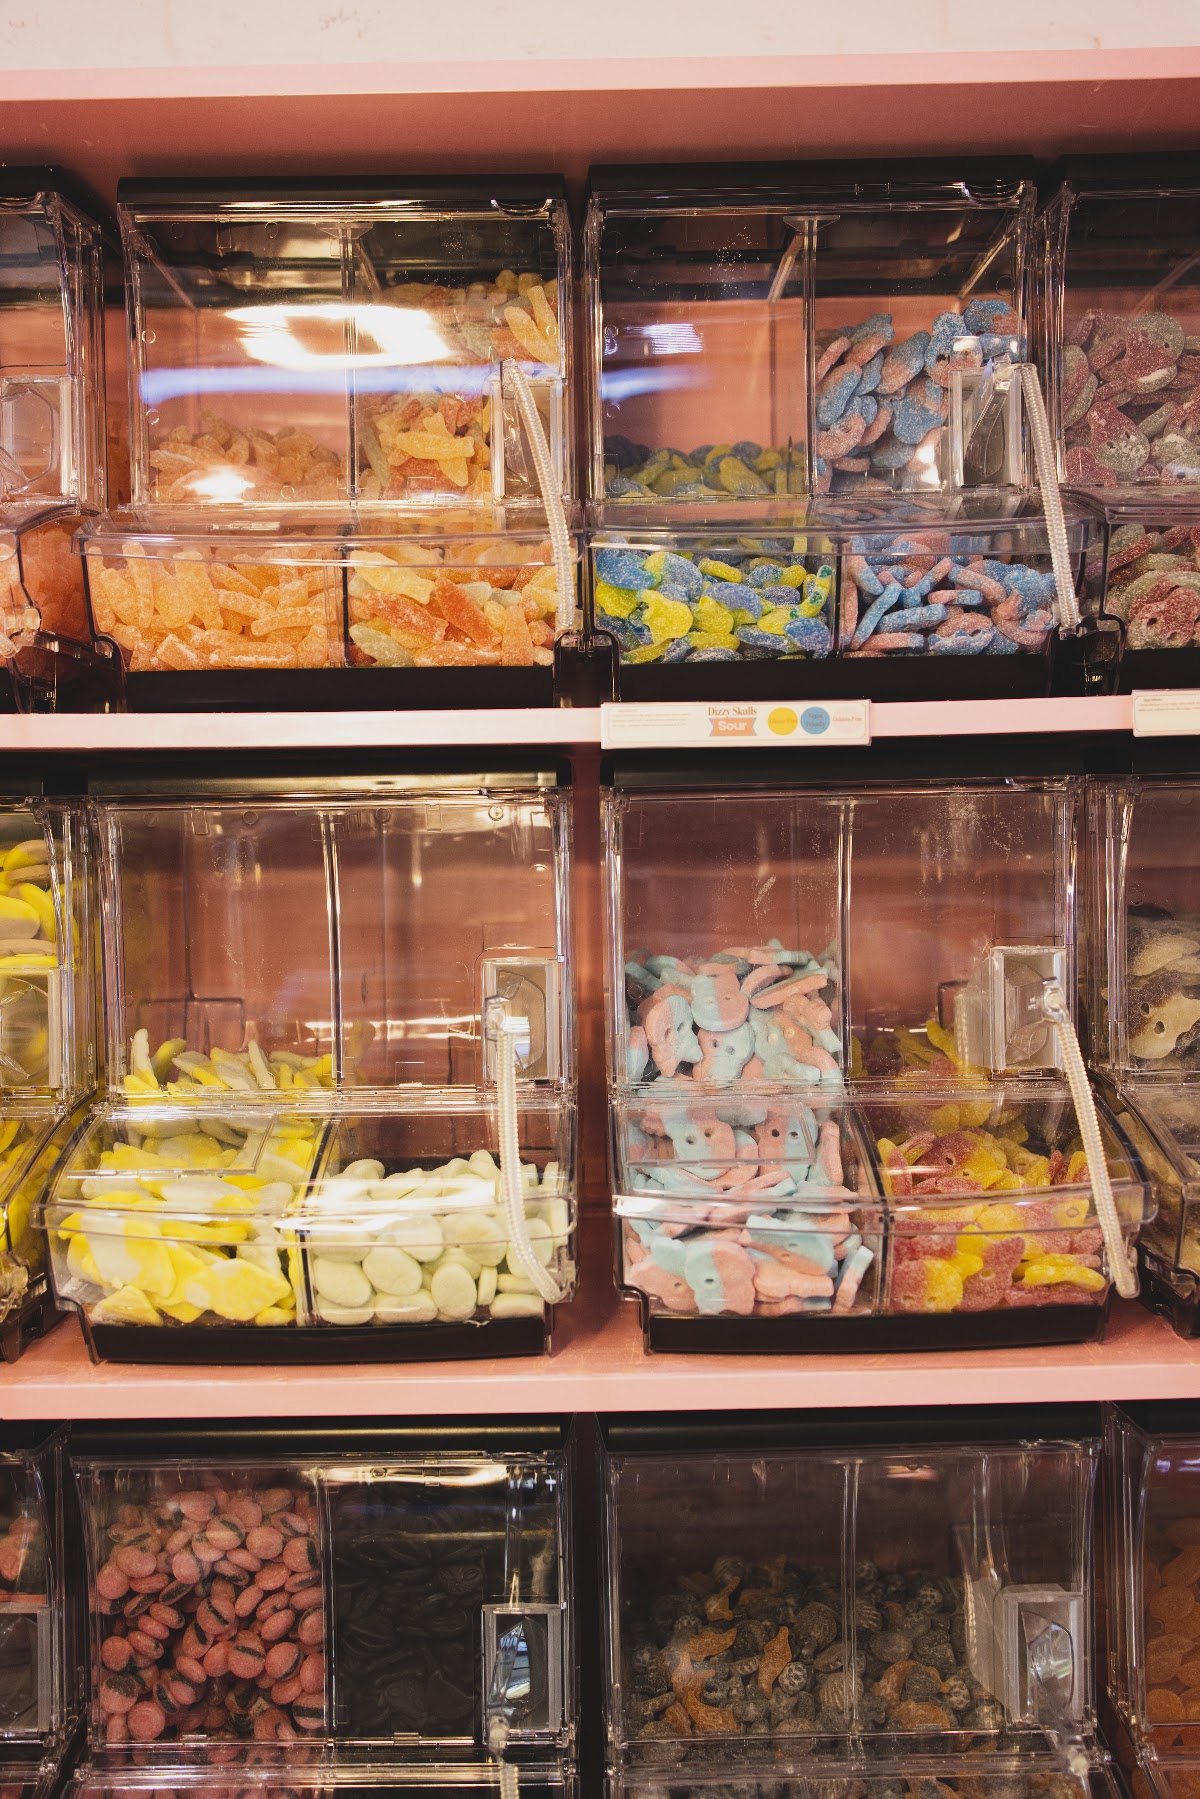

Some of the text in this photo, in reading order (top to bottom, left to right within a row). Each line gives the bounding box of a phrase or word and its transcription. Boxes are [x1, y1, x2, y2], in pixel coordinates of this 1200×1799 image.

[708, 705, 758, 718] Dizzy Skulls
[718, 720, 747, 731] Sour
